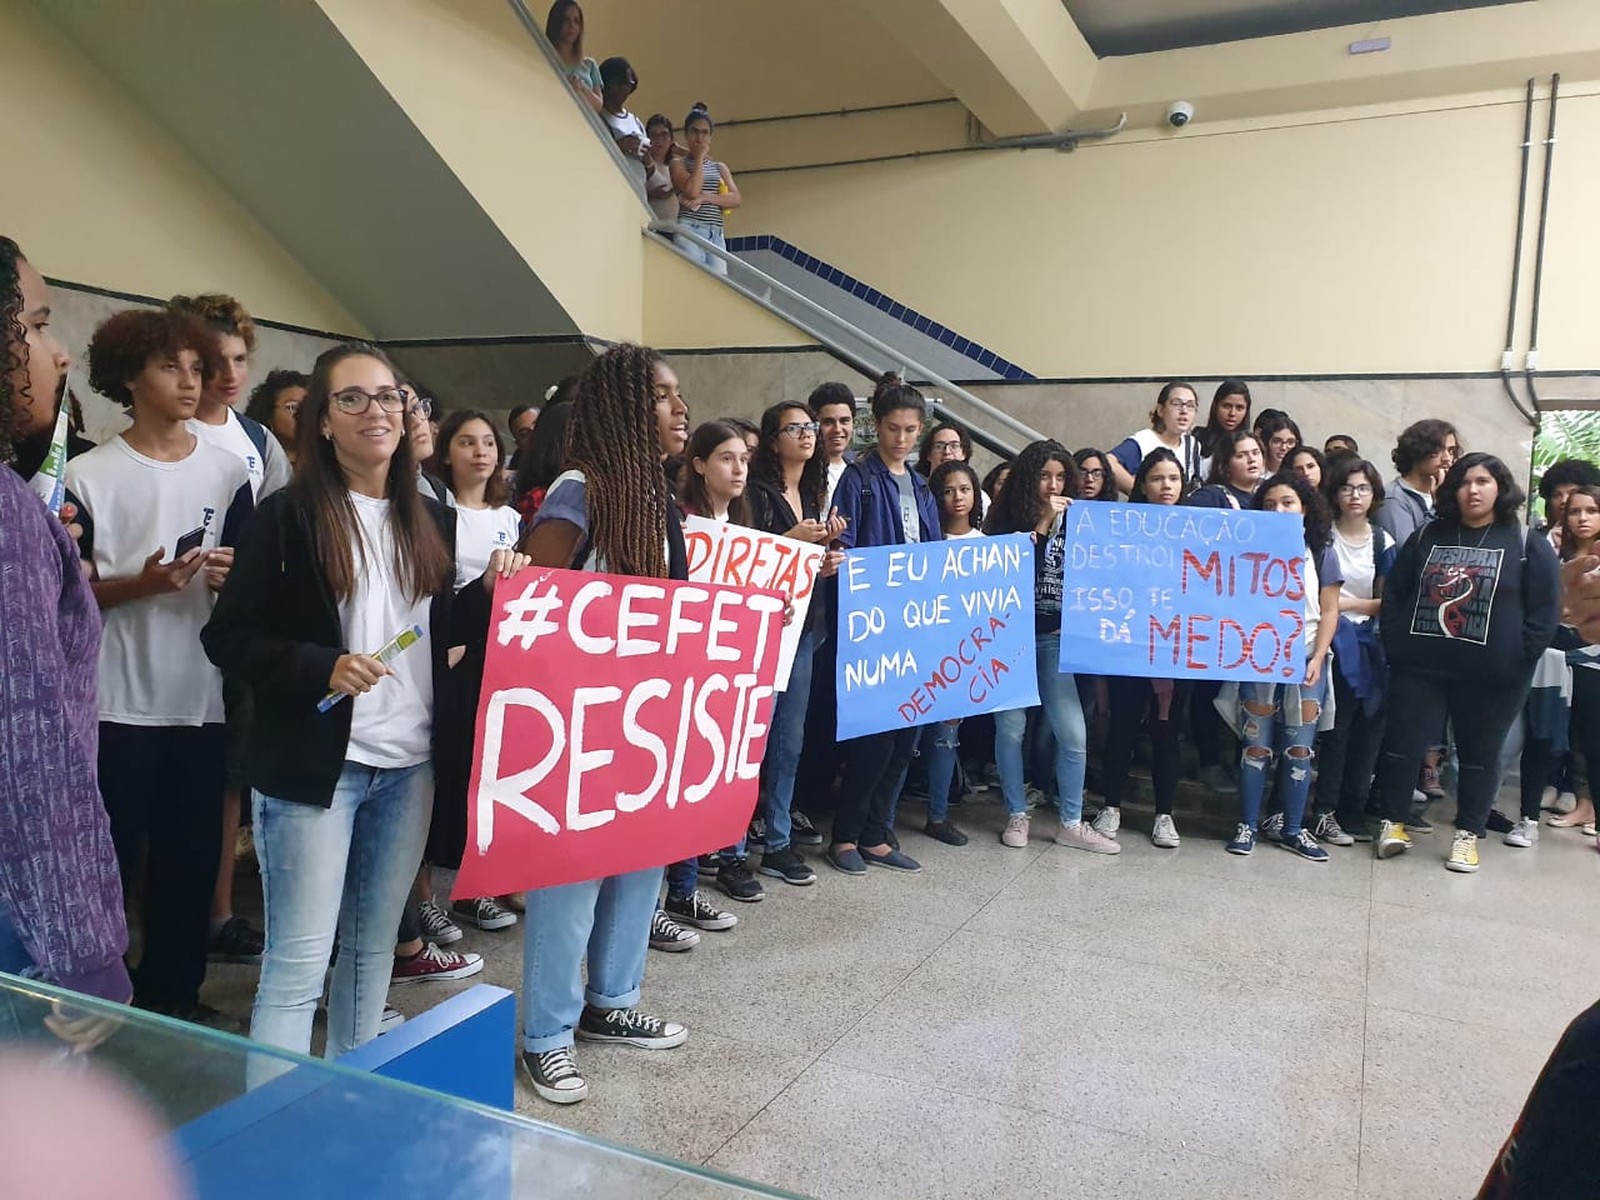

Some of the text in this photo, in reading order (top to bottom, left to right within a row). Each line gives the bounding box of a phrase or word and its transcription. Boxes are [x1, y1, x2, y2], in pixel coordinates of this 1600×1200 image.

[1077, 509, 1256, 546] A EDUCAÇÃO
[848, 543, 1030, 594] E EU ACHAN-
[1181, 549, 1305, 600] MITOS
[497, 576, 784, 672] #CEFET
[848, 585, 1022, 643] DO QUE VIVIA
[1099, 608, 1305, 677] DÁ MEDO?
[845, 649, 918, 692] NUMA
[898, 613, 1011, 724] DEMOCRA-
[476, 672, 773, 856] RESISTE
